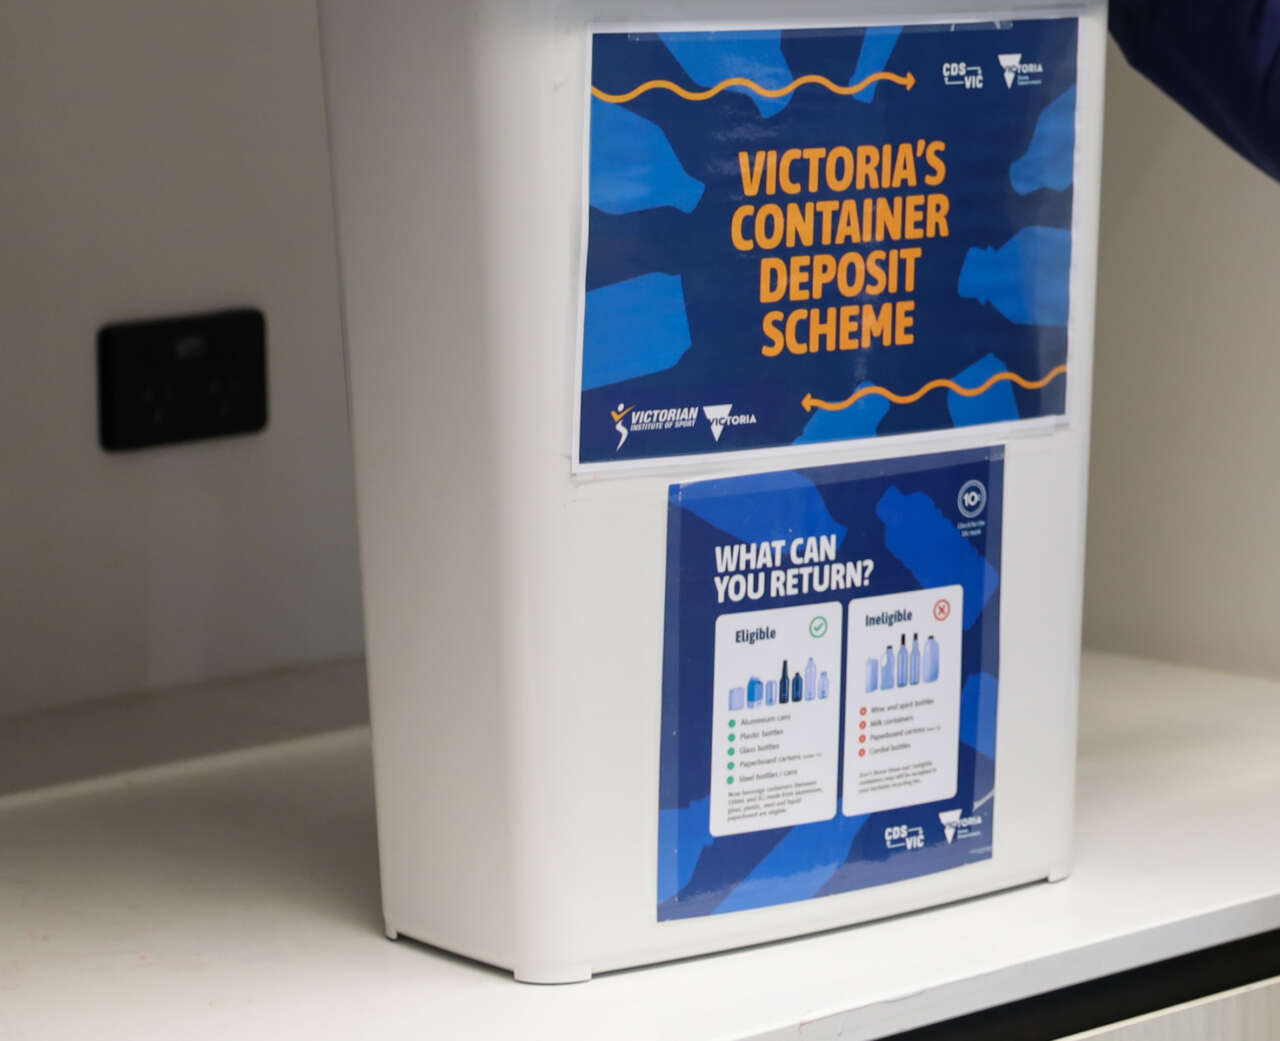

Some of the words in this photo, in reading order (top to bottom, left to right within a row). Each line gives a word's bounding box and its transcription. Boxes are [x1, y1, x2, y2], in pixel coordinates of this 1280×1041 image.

[942, 62, 967, 77] CDS
[964, 75, 984, 89] VIC
[737, 139, 947, 197] VICTORIA'S
[731, 193, 950, 251] CONTAINER
[759, 247, 922, 304] DEPOSIT
[761, 301, 915, 357] SCHEME
[631, 406, 699, 424] VICTORIAN
[630, 421, 663, 432] INSTITUTE
[664, 420, 673, 429] OF
[674, 418, 696, 429] SPORT
[715, 539, 786, 573] WHAT
[790, 534, 837, 564] CAN
[714, 571, 765, 603] YOU
[770, 559, 874, 598] RETURN?
[865, 608, 912, 627] Ineligible
[735, 626, 776, 644] Eligible
[884, 824, 908, 841] CDS
[905, 834, 925, 850] VIC
